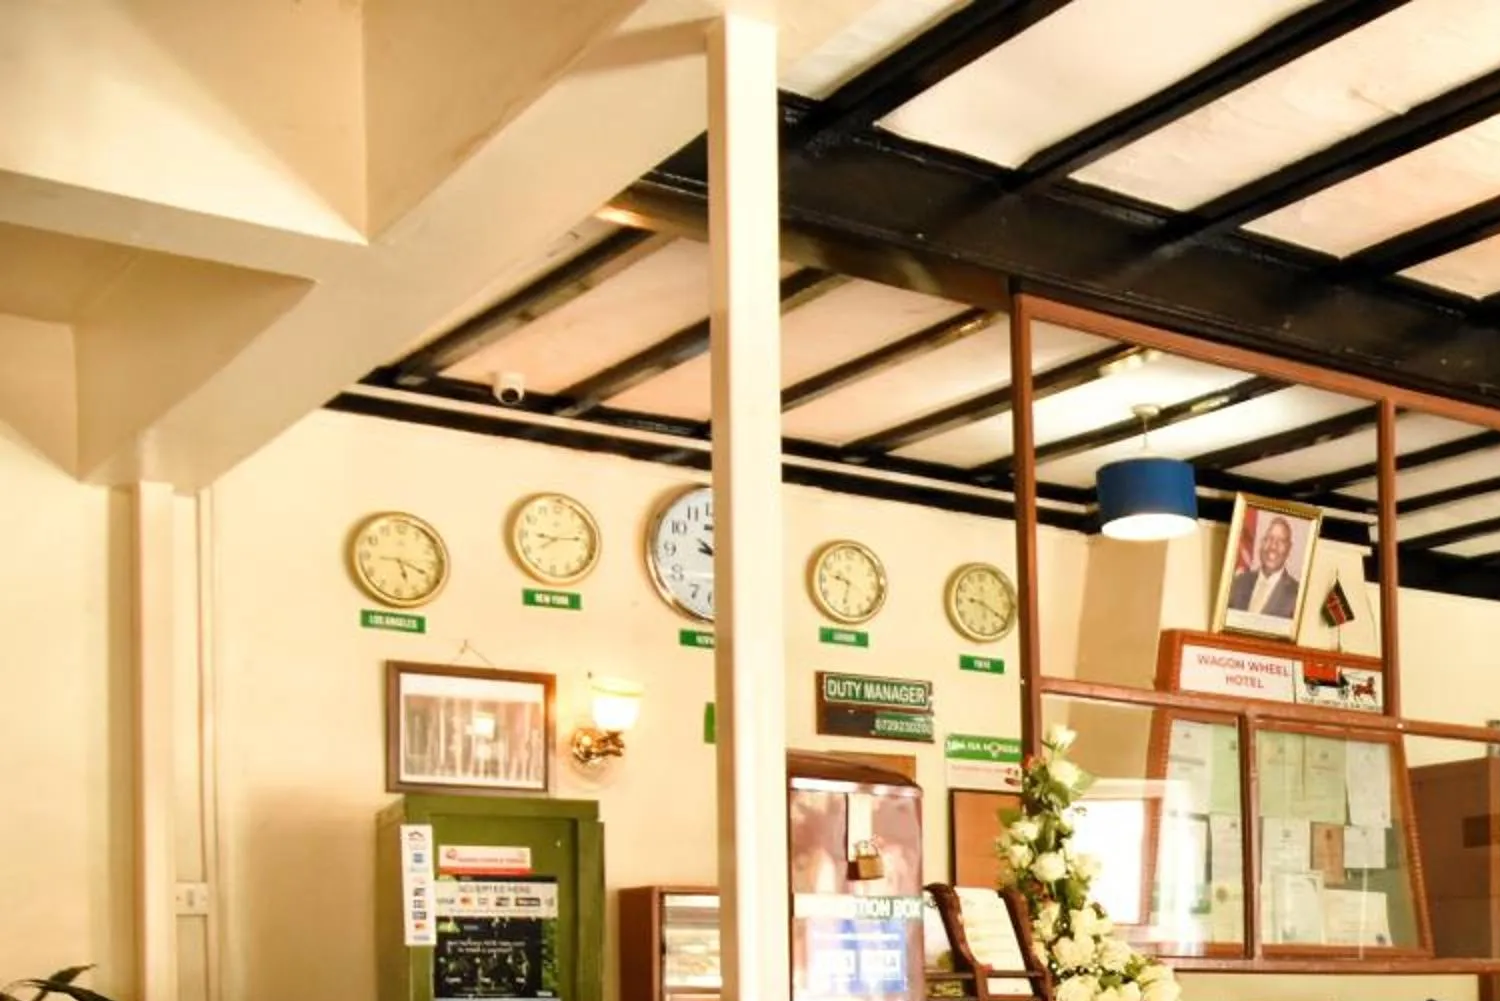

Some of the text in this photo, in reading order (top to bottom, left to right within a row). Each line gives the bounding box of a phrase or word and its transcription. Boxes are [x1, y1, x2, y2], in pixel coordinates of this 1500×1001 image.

[687, 504, 699, 521] 11
[671, 519, 687, 534] 10
[664, 541, 677, 557] 9
[535, 594, 550, 604] NEW
[690, 583, 699, 599] 7
[1196, 654, 1291, 677] WAGON WHEEL
[1225, 675, 1265, 689] HOTEL
[827, 679, 926, 703] DUTY MANAGER
